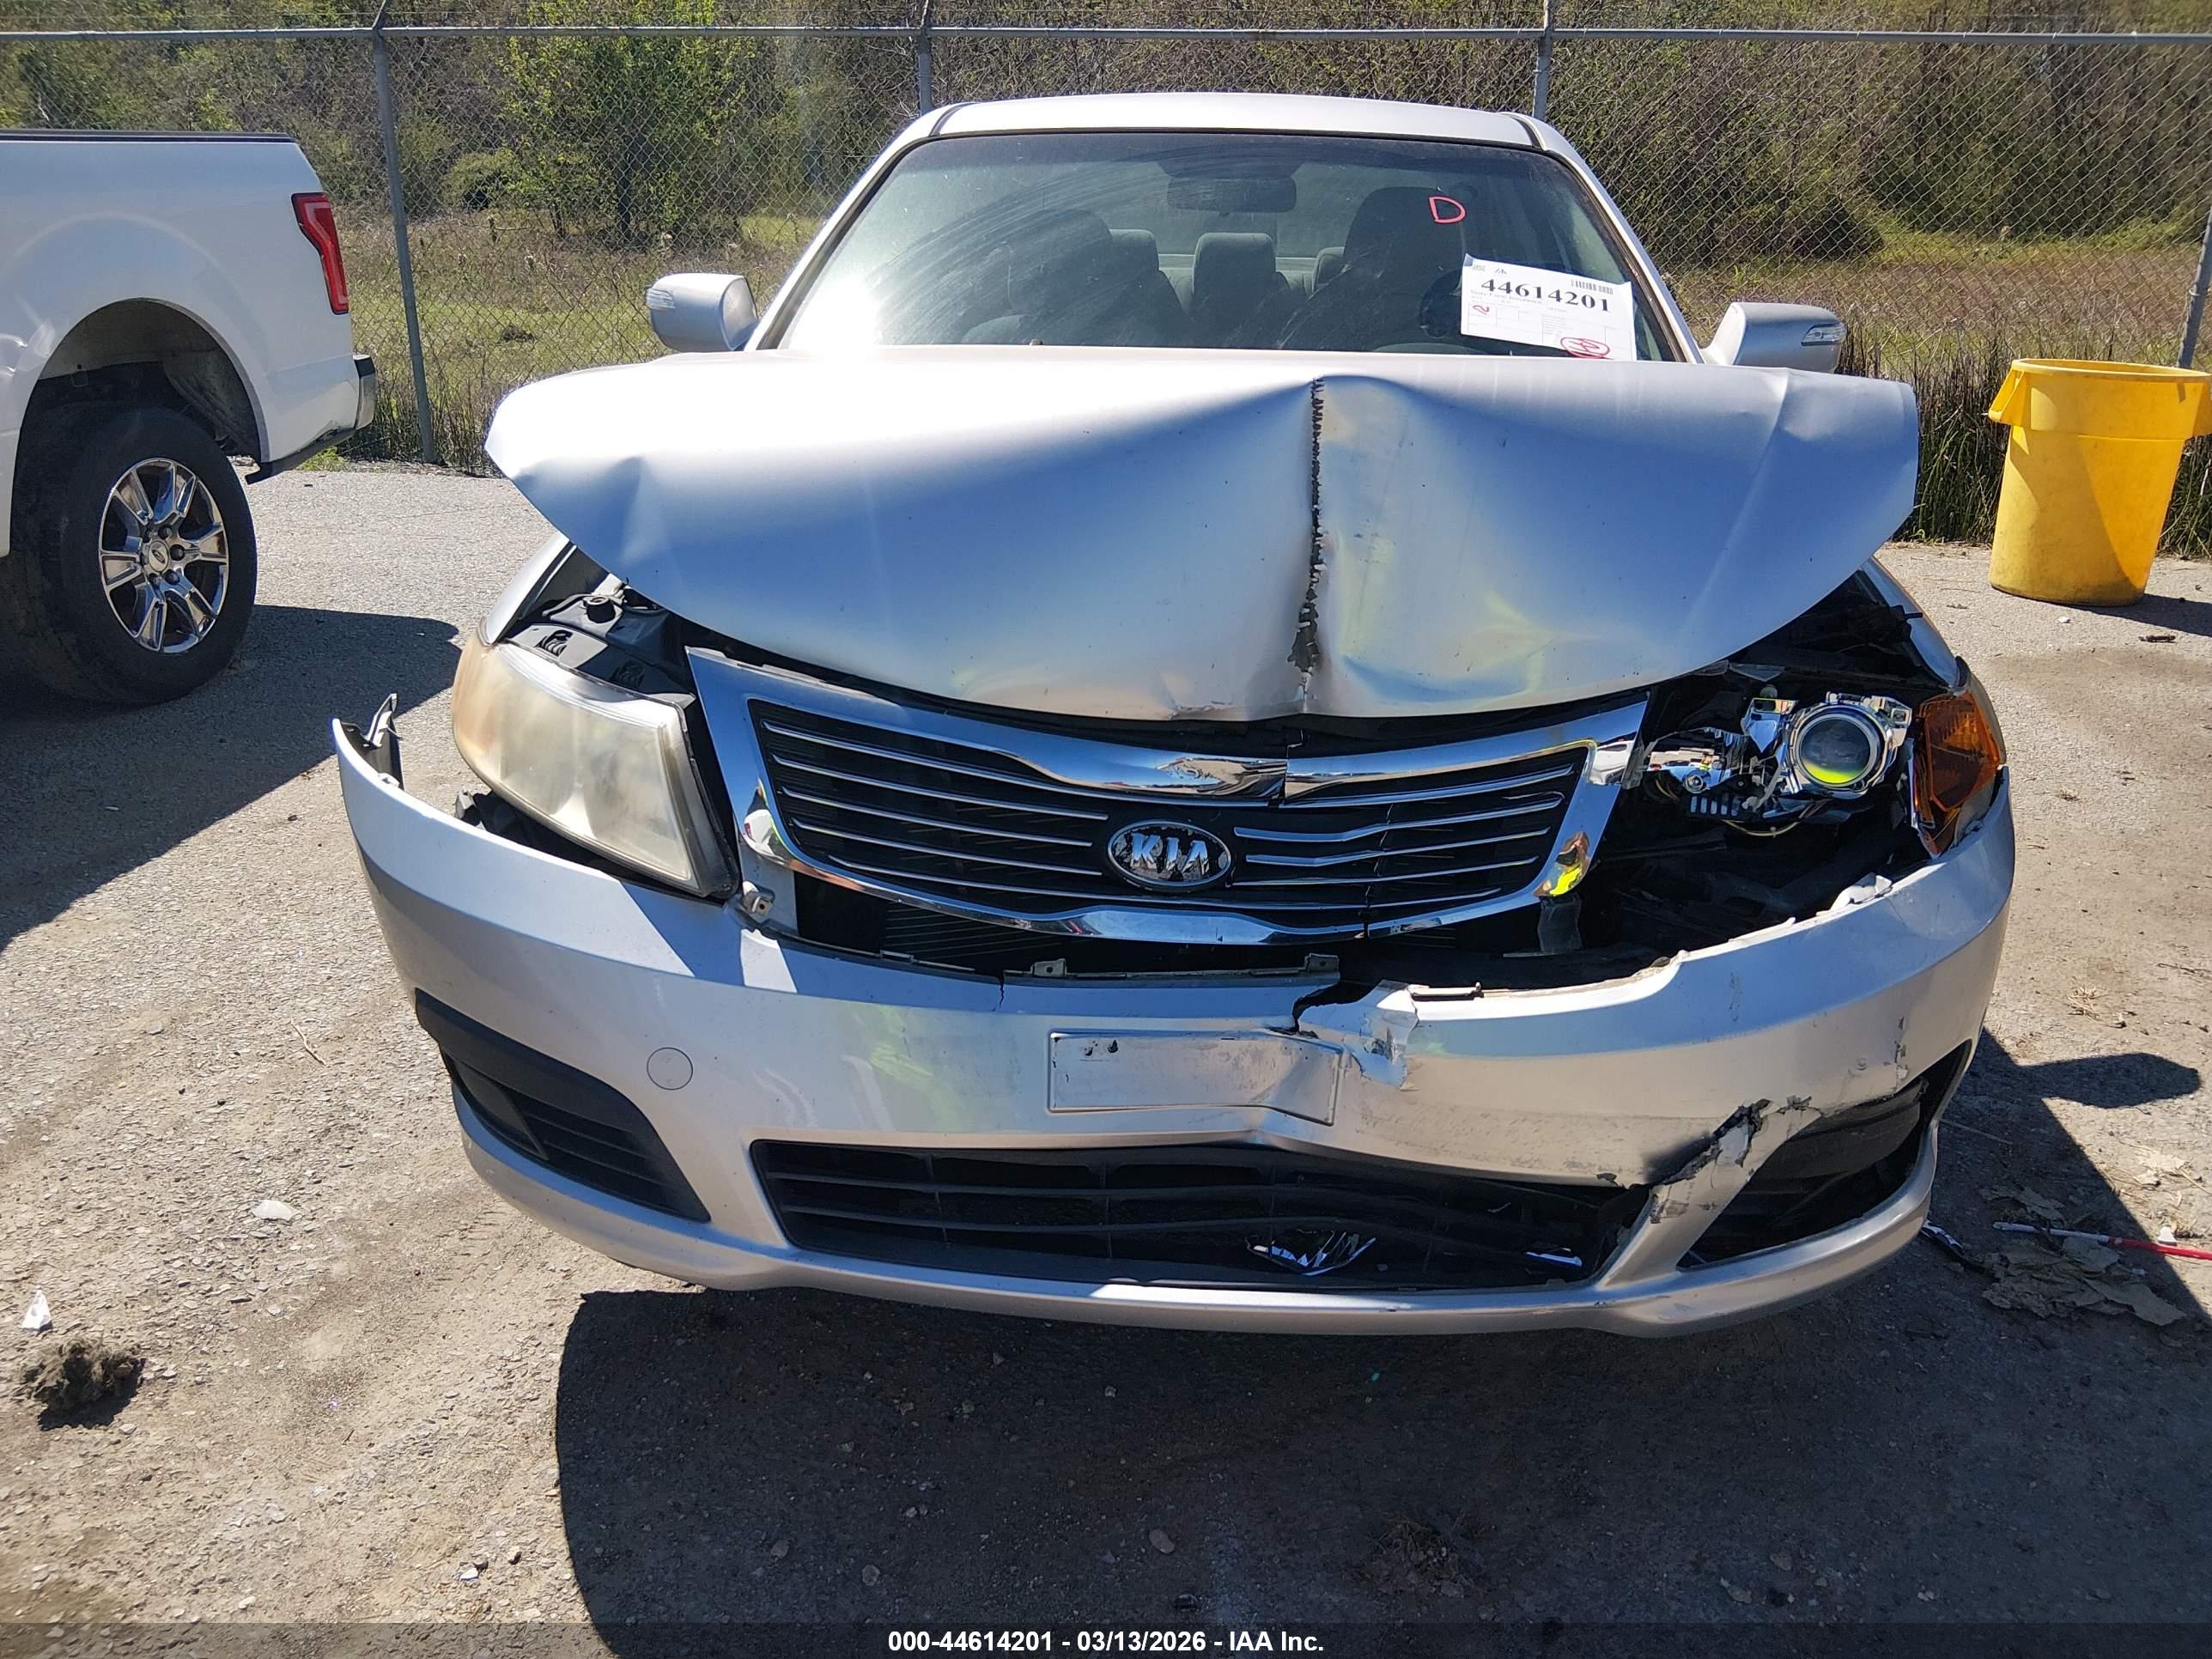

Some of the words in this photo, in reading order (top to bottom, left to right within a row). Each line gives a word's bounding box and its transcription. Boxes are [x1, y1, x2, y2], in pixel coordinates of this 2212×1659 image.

[1428, 196, 1466, 223] D
[1481, 278, 1612, 312] 44614201
[1130, 832, 1209, 875] KIA
